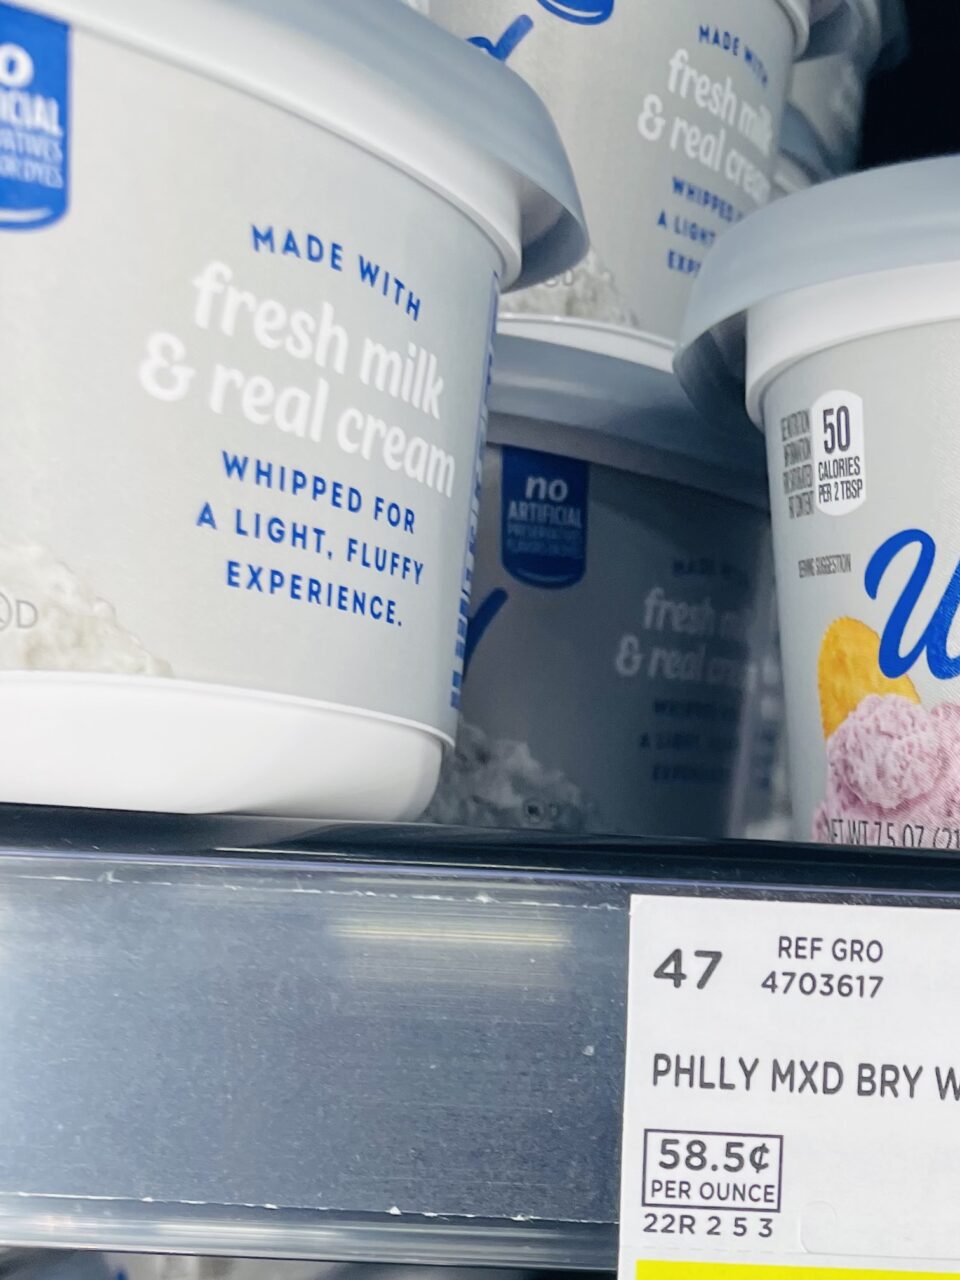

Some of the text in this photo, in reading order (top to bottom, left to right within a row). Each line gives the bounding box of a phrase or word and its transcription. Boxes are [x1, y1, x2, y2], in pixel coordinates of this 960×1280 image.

[699, 25, 740, 56] MADE
[0, 43, 35, 88] o
[668, 49, 738, 125] fresh
[637, 94, 666, 141] &
[670, 115, 725, 172] real
[251, 223, 422, 322] MADE WITH
[192, 260, 446, 420] fresh milk
[138, 331, 456, 498] & real cream
[822, 405, 851, 454] 50
[524, 475, 569, 502] no
[818, 456, 861, 481] CALORIES
[221, 449, 416, 536] WHIPPED FOR
[818, 479, 863, 504] PER 2 TBSP
[196, 501, 426, 587] A LIGHT, FLUFFY
[225, 560, 403, 628] EXPERIENCE.
[874, 821, 895, 848] 75
[652, 948, 724, 991] 47
[777, 935, 884, 965] REF GRO
[761, 971, 884, 999] 4703617
[652, 1052, 760, 1091] PHLLY
[770, 1057, 845, 1095] MXD
[856, 1063, 925, 1099] BRY
[657, 1137, 771, 1175] 58.5¢
[650, 1178, 776, 1204] PER OUNCE
[642, 1211, 697, 1236] 22R
